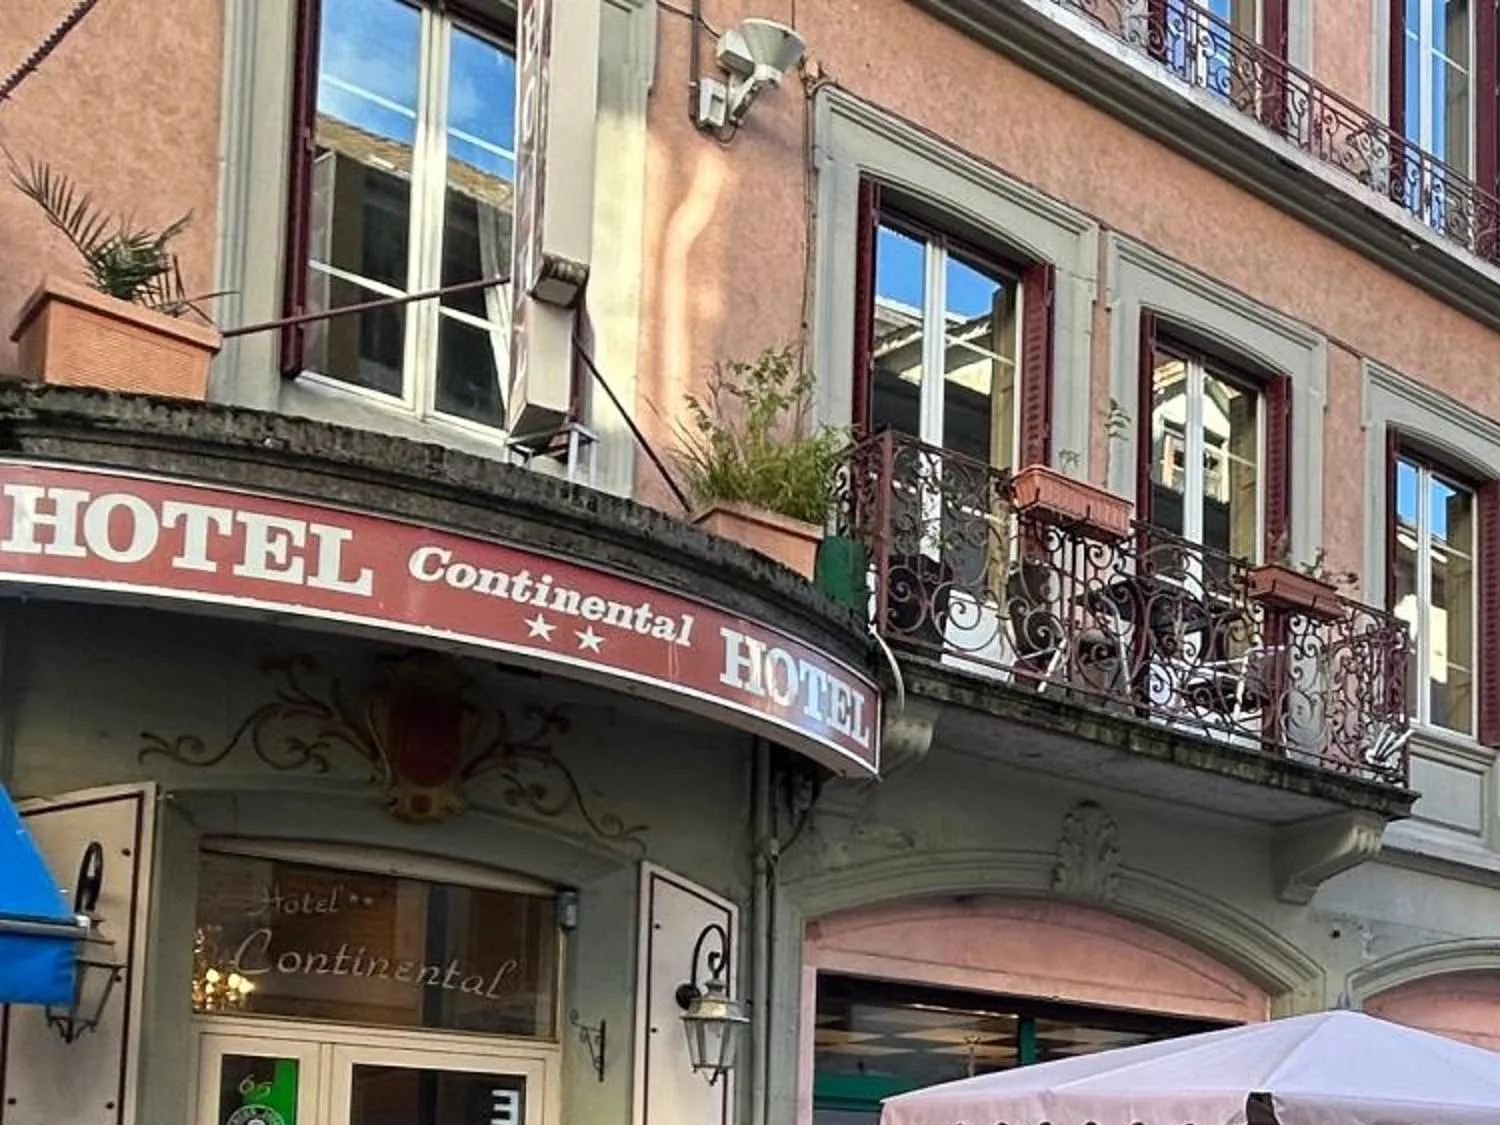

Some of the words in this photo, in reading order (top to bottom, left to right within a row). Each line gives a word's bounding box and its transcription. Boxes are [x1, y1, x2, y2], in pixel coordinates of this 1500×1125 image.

[2, 483, 373, 597] HOTEL
[408, 545, 697, 648] Continental
[719, 626, 870, 749] HOTEL
[234, 928, 518, 999] Continental
